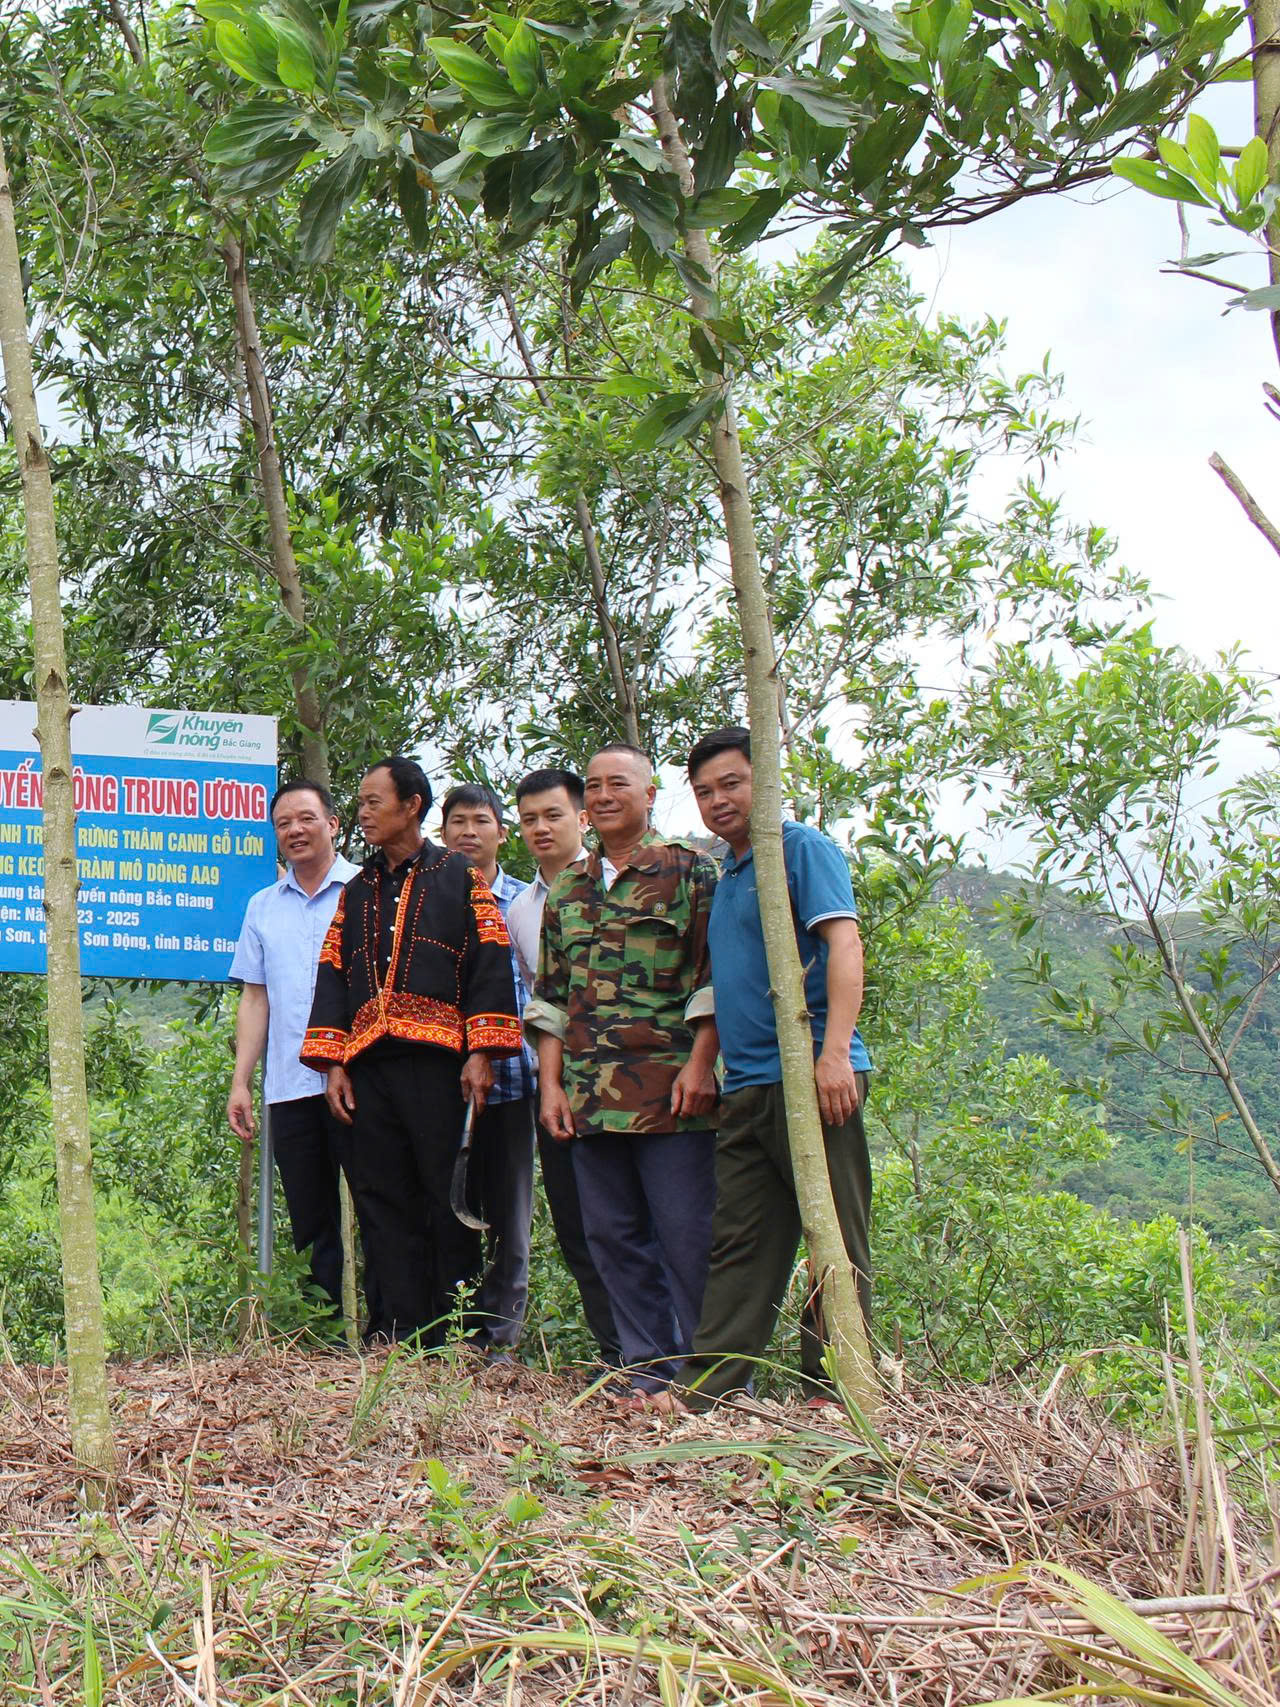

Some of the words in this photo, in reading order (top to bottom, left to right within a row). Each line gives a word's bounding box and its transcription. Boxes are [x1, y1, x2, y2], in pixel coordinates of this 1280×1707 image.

[180, 732, 220, 751] nông
[238, 739, 261, 750] Giang
[72, 767, 117, 814] ÔNG
[122, 776, 199, 818] TRUNG
[203, 777, 267, 822] ƯƠNG
[78, 824, 118, 848] RỪNG
[122, 827, 164, 851] THÂM
[168, 832, 208, 854] CANH
[211, 828, 232, 855] GỖ
[235, 831, 264, 857] LỚN
[119, 858, 143, 882] MÔ
[146, 859, 187, 884] DÒNG
[190, 865, 220, 886] AA9
[109, 889, 142, 906] nông
[146, 889, 171, 907] Bắc
[175, 893, 214, 909] Giang
[77, 910, 93, 924] 23
[107, 911, 140, 926] 2025
[5, 928, 35, 945] Sơn,
[83, 931, 109, 946] Sơn
[112, 933, 151, 951] Động,
[154, 934, 180, 950] tỉnh
[183, 934, 209, 951] Bắc
[213, 938, 238, 952] Gia
